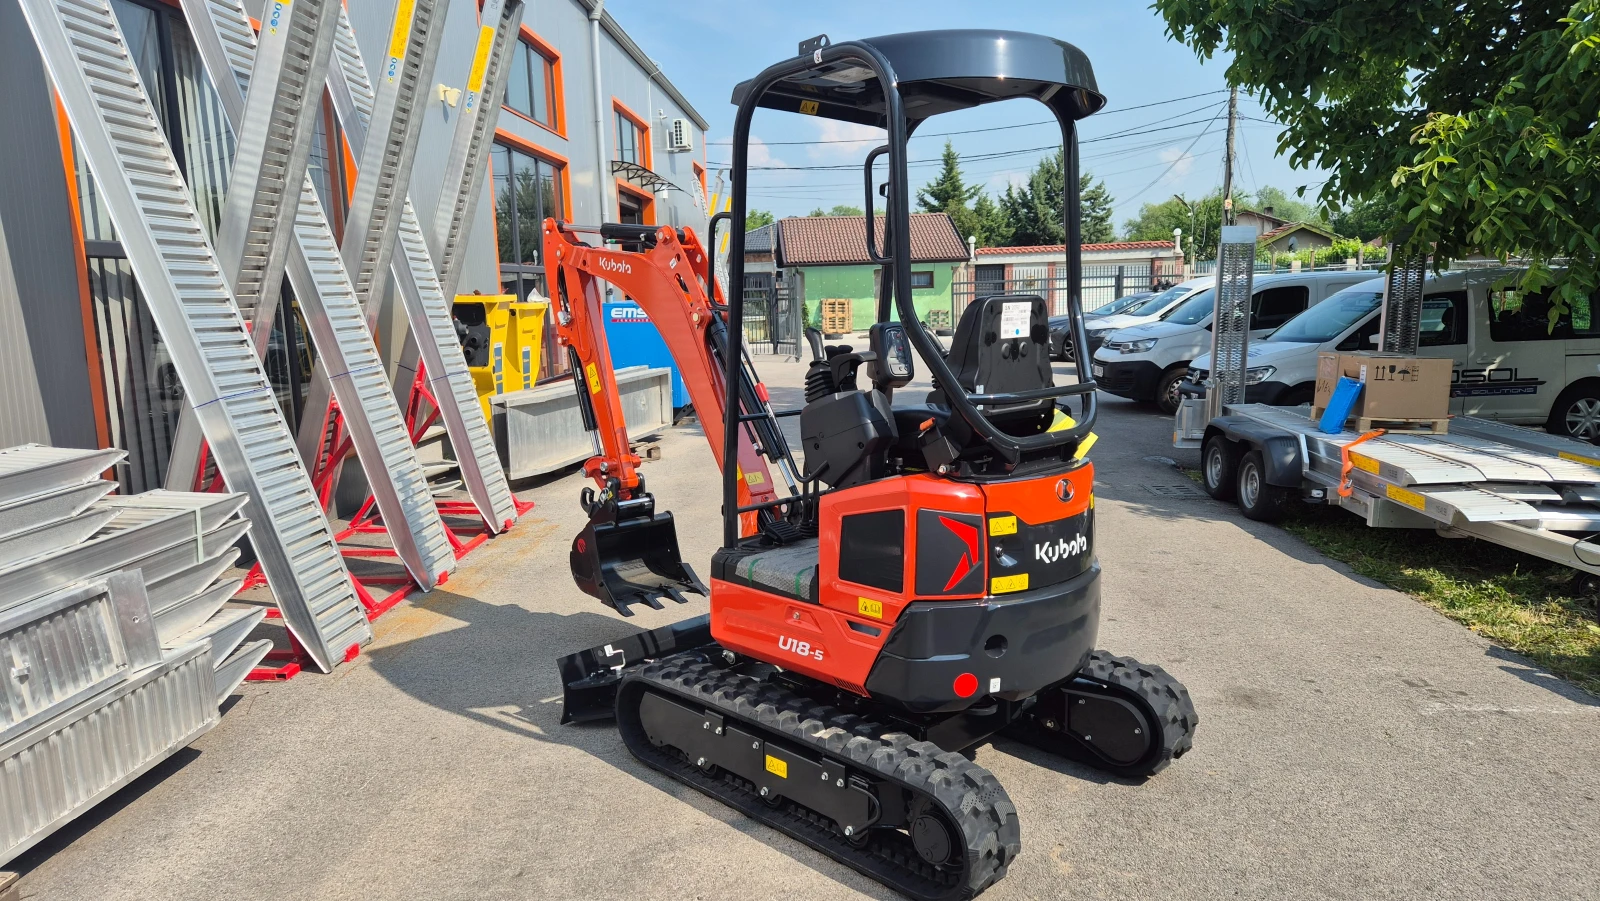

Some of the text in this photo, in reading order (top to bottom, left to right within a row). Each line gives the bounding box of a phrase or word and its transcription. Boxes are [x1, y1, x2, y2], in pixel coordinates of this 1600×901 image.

[599, 256, 632, 274] Kubota
[1471, 387, 1535, 395] SOLUTIONS
[1035, 532, 1087, 564] Kubota
[778, 635, 824, 661] U18-5
